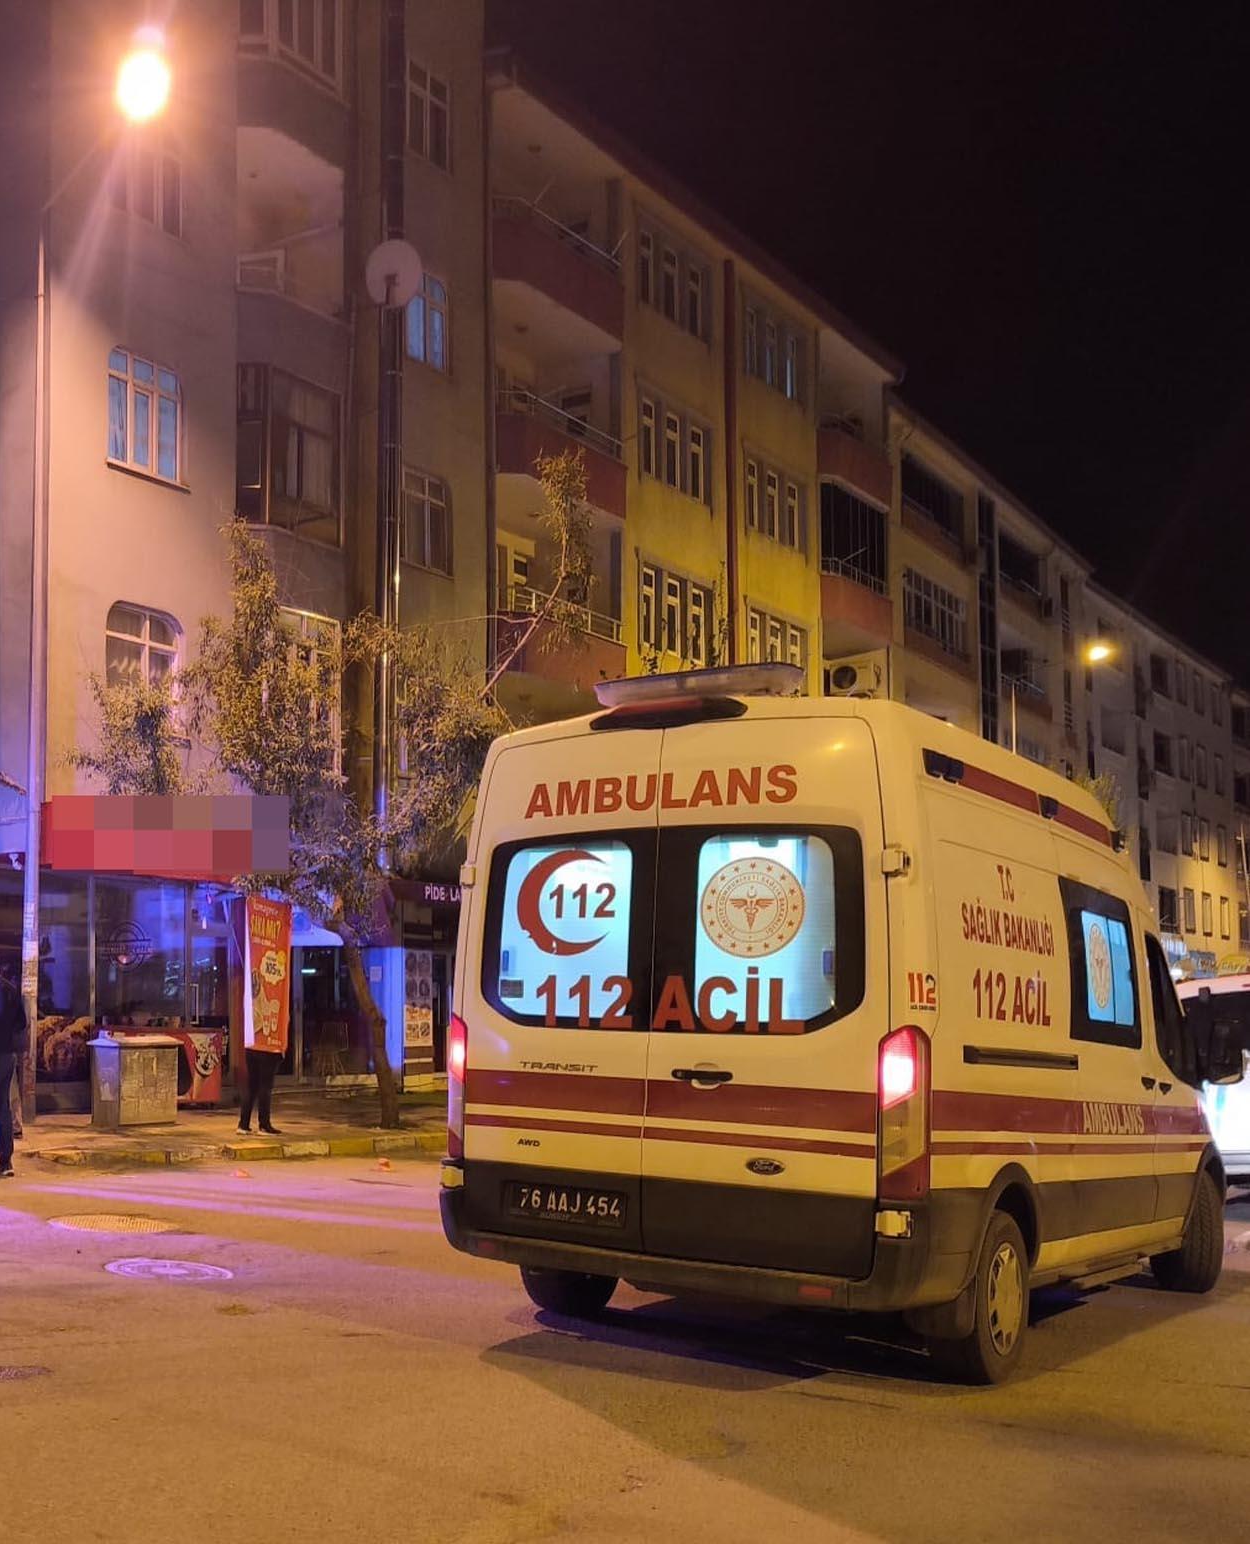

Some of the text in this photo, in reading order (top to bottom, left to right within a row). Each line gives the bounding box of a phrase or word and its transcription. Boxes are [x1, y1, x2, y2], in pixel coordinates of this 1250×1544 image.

[524, 764, 798, 819] AMBULANS
[549, 882, 617, 919] 112
[961, 898, 1055, 957] SAĞLIK BAKANLIĞI
[535, 966, 806, 1035] 112 ACİL
[908, 972, 936, 1004] 112
[973, 968, 1052, 1027] 112 ACİL
[519, 1061, 599, 1073] TRANSIT
[1082, 1101, 1145, 1135] AMBULANS
[517, 1138, 541, 1147] AWD
[520, 1188, 541, 1209] 76
[546, 1190, 582, 1214] AAJ
[586, 1196, 621, 1218] 454
